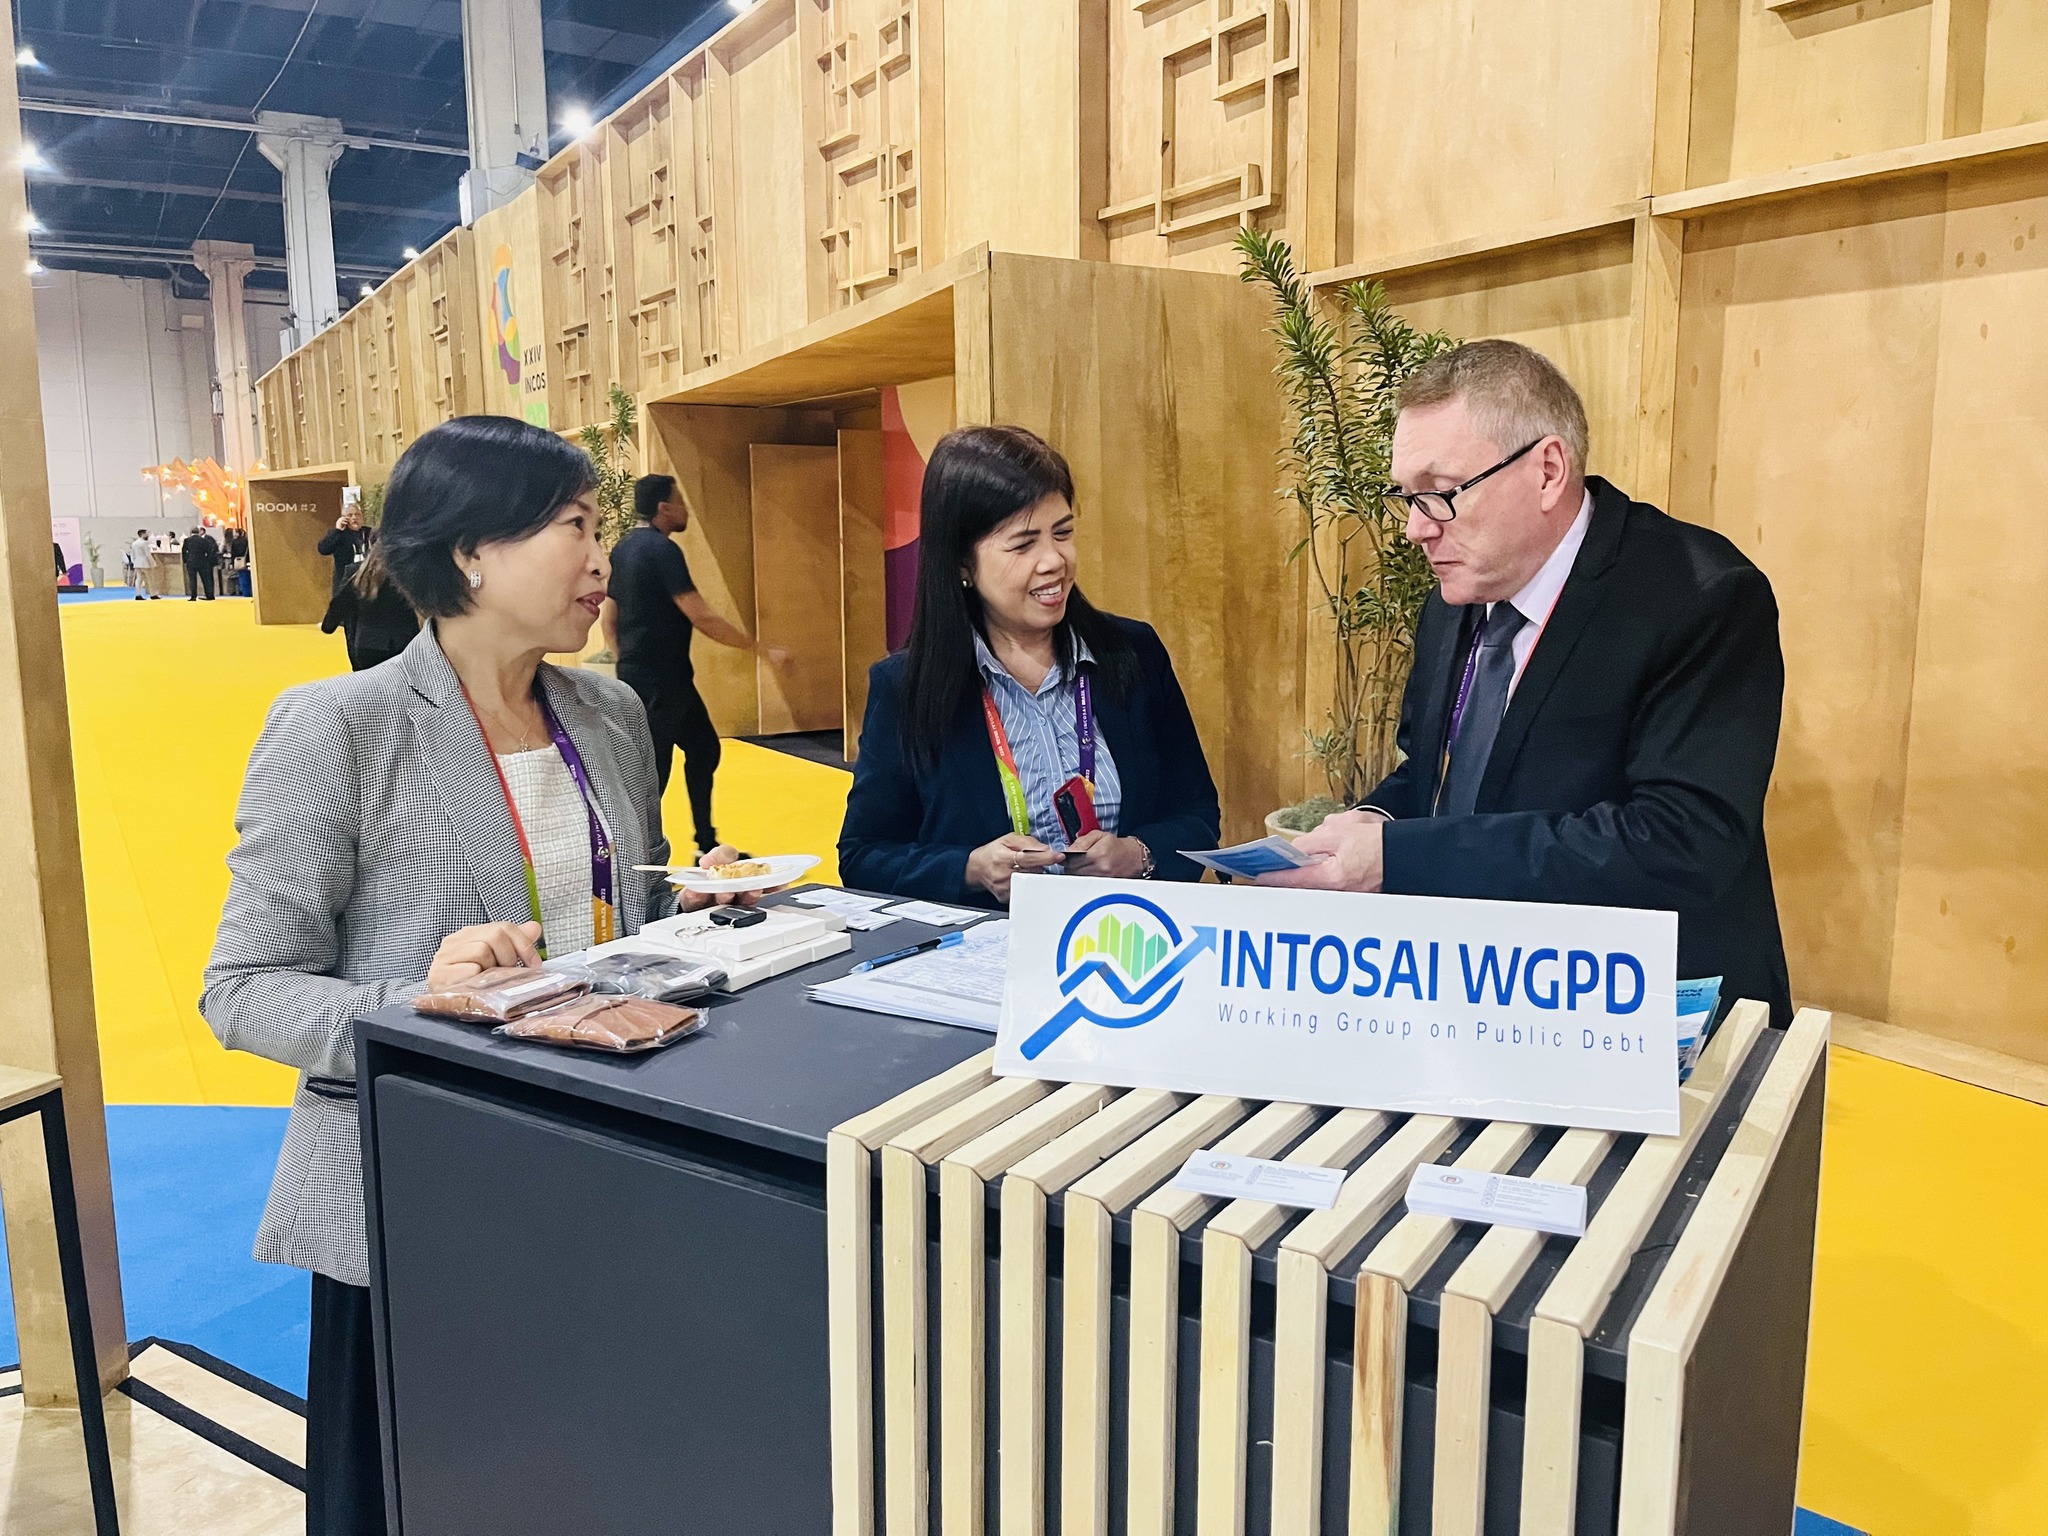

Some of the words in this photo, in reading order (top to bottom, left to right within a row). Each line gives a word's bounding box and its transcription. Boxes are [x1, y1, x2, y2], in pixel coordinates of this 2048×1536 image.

[524, 344, 542, 366] XXIV
[256, 502, 298, 512] ROOM
[300, 503, 318, 513] #2
[1221, 929, 1439, 1001] INTOSAI
[1458, 943, 1646, 1015] WGPD
[1218, 1003, 1318, 1034] Working
[1336, 1012, 1411, 1040] Group
[1430, 1023, 1456, 1040] on
[1476, 1022, 1562, 1047] Public
[1582, 1029, 1644, 1054] Debt
